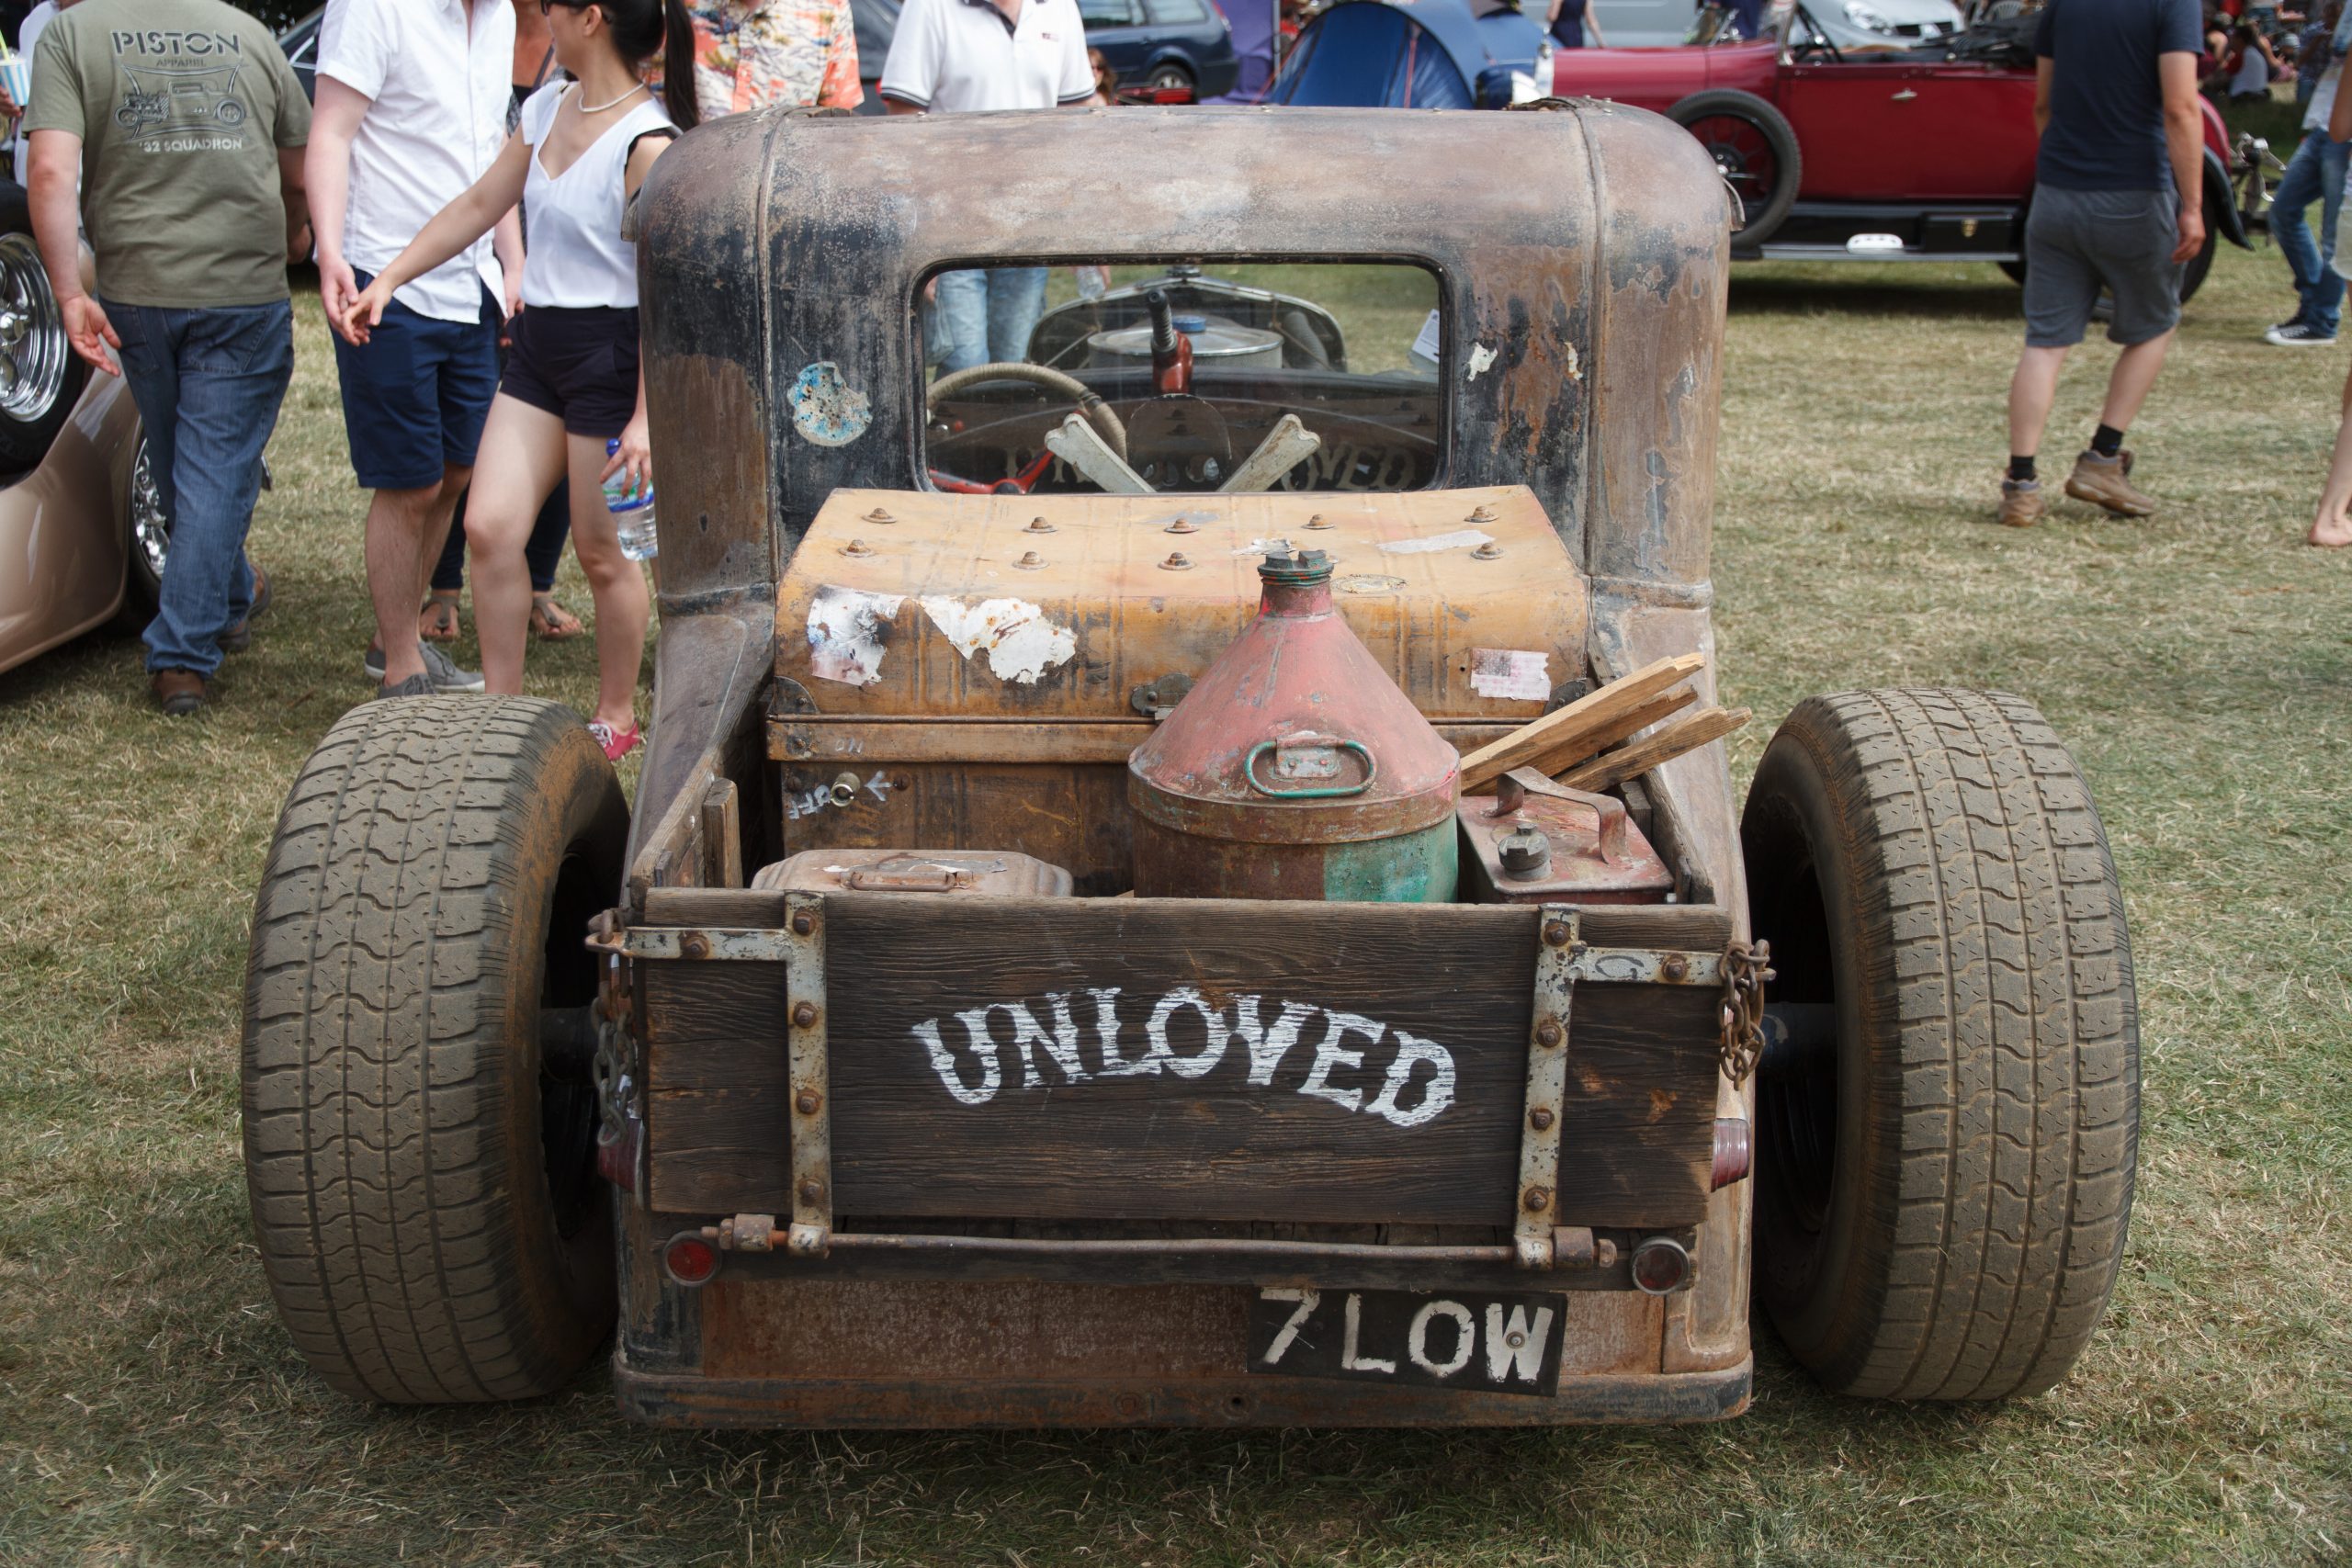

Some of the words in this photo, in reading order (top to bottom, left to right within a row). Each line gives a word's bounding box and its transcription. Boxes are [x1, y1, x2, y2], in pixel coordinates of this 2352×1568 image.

[111, 29, 243, 57] PISTON
[156, 58, 207, 67] APPAREL
[164, 139, 243, 152] SQUADRON
[912, 987, 1456, 1127] UNLOVED
[1341, 1292, 1555, 1383] LOW
